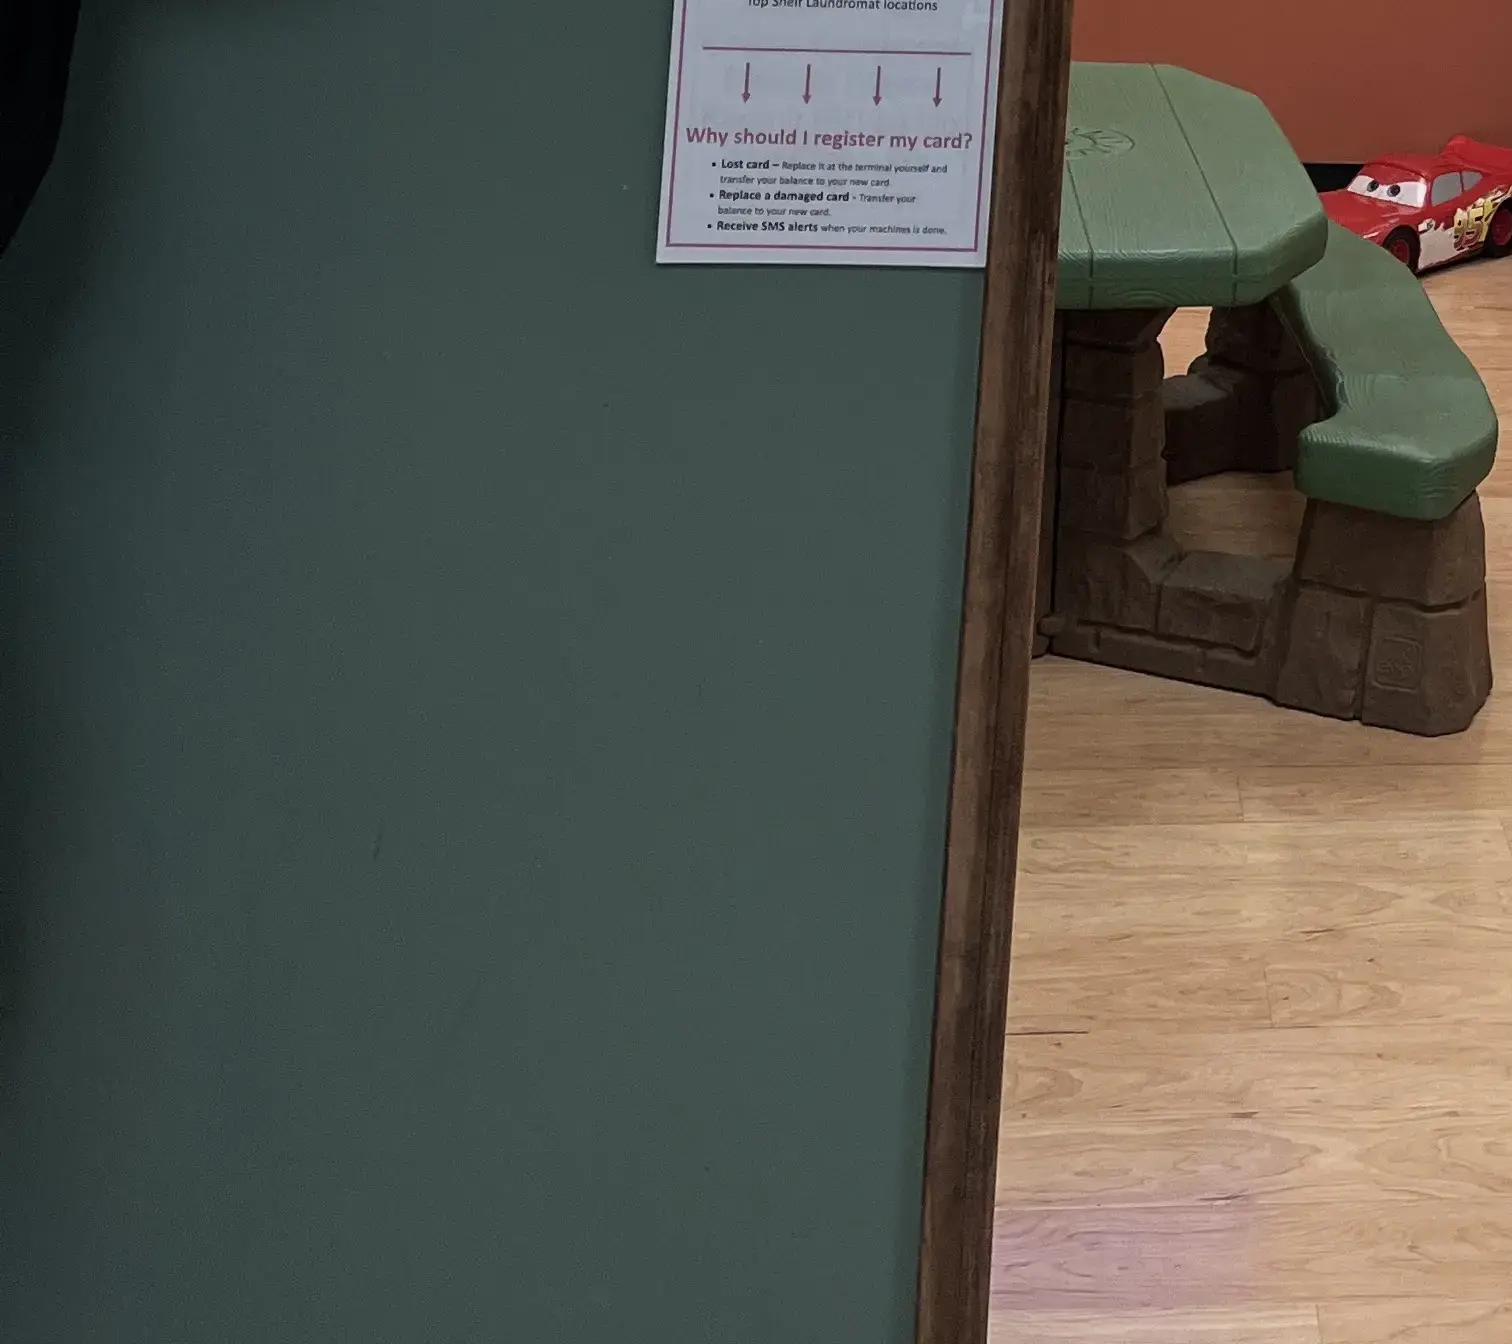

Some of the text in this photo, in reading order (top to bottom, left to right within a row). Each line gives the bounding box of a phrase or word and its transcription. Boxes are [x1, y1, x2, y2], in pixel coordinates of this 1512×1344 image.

[686, 126, 973, 152] Why should I register my card?
[721, 158, 744, 169] Lost
[746, 159, 770, 170] card
[781, 160, 816, 172] Replace
[818, 162, 825, 171] it
[826, 162, 836, 171] at
[838, 162, 853, 172] the
[855, 163, 893, 173] terminal
[894, 164, 930, 175] yourself
[931, 164, 948, 174] and
[720, 174, 755, 185] transfer
[756, 177, 777, 186] your
[779, 175, 814, 186] balance
[816, 176, 826, 186] to
[828, 178, 848, 188] your
[849, 178, 868, 187] new
[719, 189, 762, 202] Replace
[764, 192, 772, 201] a
[773, 191, 824, 203] damaged
[826, 191, 850, 202] card
[858, 193, 895, 203] Transfer
[896, 195, 917, 205] your
[754, 207, 764, 216] to
[766, 208, 786, 217] your
[788, 208, 808, 217] new
[716, 220, 759, 232] Receive
[761, 221, 786, 232] SMS
[788, 222, 818, 233] alerts
[820, 224, 845, 233] when
[847, 225, 867, 235] your
[869, 225, 911, 235] machines
[1453, 206, 1484, 252] 95
